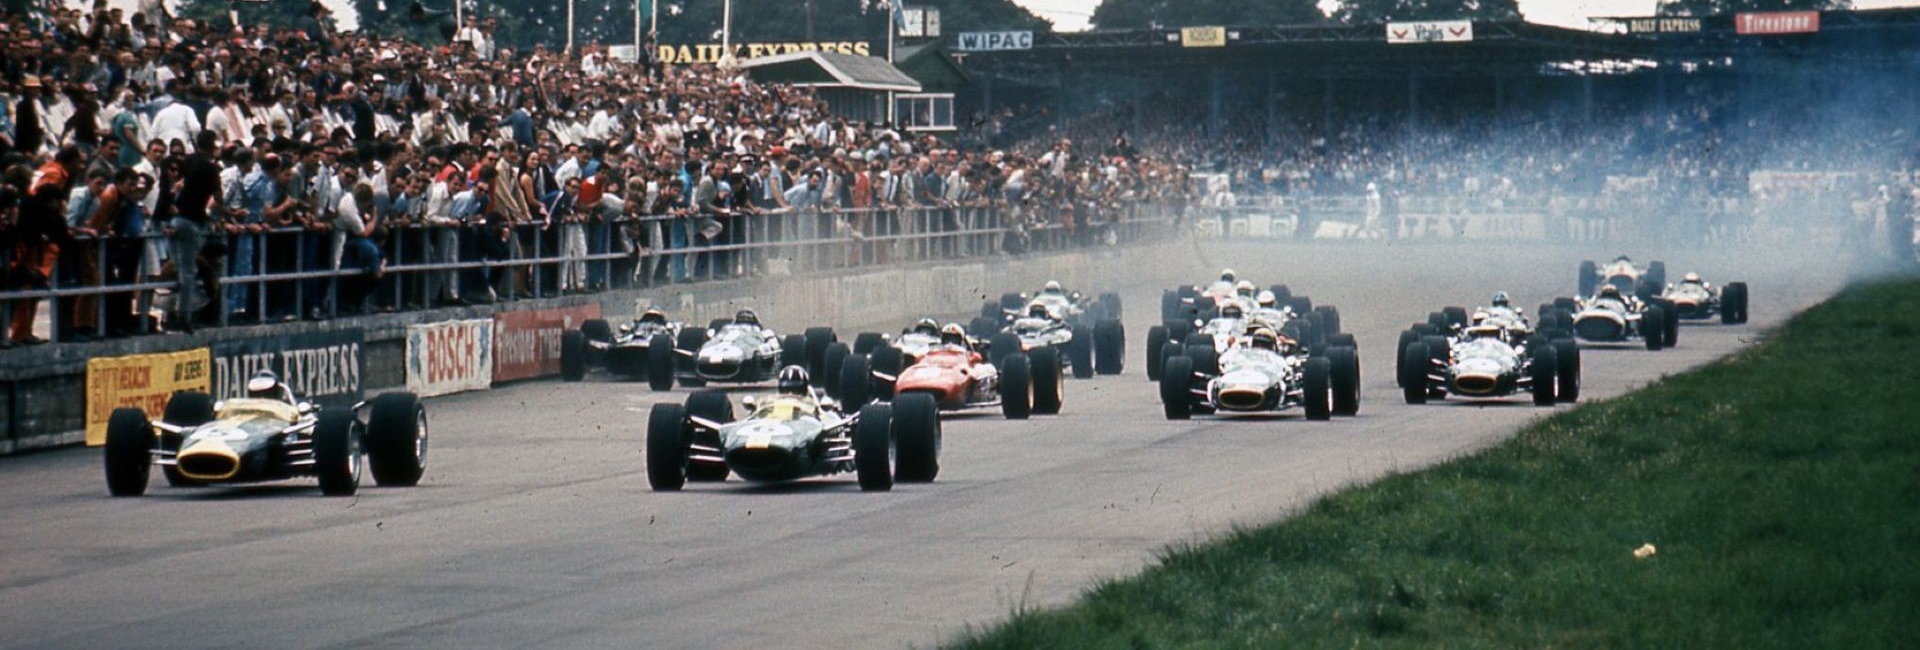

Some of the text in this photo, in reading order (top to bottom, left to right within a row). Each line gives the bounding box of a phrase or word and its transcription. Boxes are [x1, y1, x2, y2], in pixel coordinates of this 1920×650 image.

[1631, 19, 1701, 32] DAILY EXPRESS
[962, 32, 1030, 49] WIPAC
[658, 44, 742, 64] DAIL
[427, 324, 475, 384] BOSCH
[281, 342, 360, 400] EXPRESS
